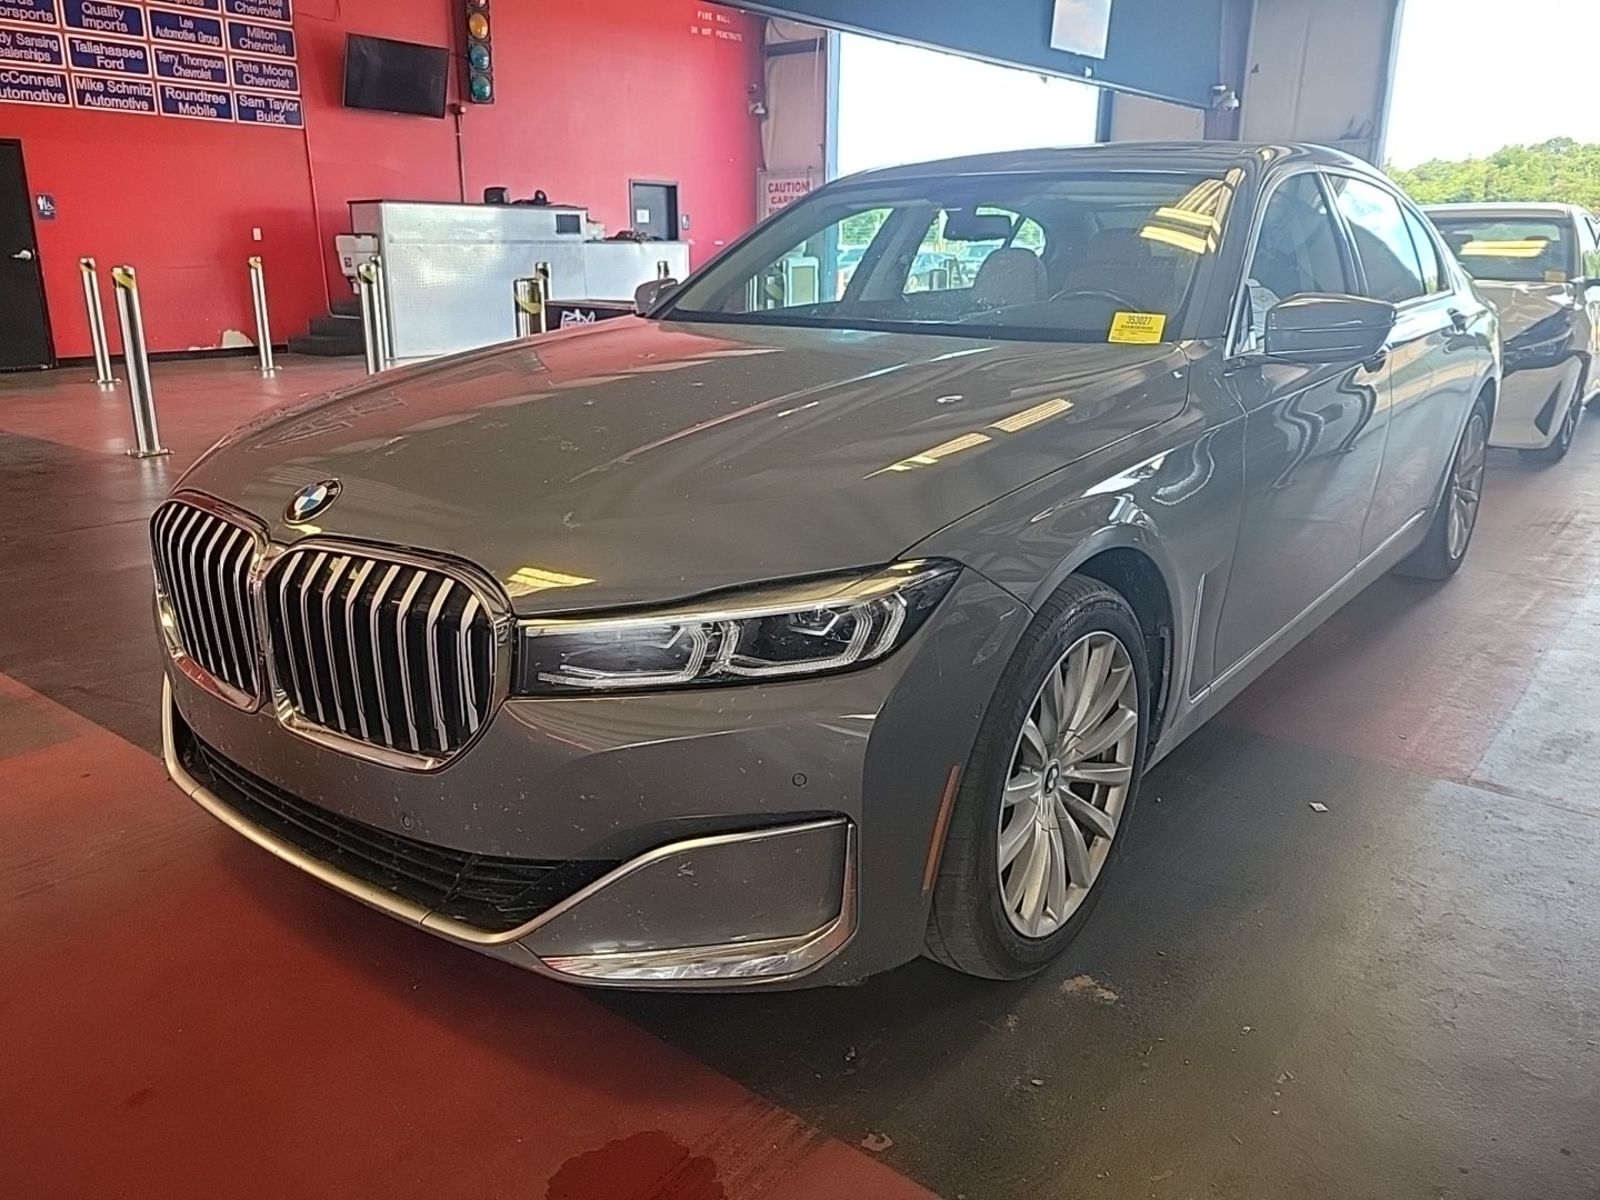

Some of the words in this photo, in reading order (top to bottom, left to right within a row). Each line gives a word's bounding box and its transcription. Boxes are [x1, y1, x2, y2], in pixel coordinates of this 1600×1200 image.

[81, 1, 125, 21] Quality
[234, 1, 282, 18] Chevrolet
[81, 13, 129, 32] Imports
[178, 15, 194, 29] Lee
[15, 32, 59, 52] Sansing
[155, 25, 197, 42] Automotive
[197, 31, 220, 46] Group
[246, 26, 278, 42] Milton
[72, 39, 144, 59] Tallahassee
[239, 37, 287, 54] Chevrolet
[96, 55, 125, 70] Ford
[156, 50, 179, 65] Terry
[180, 53, 224, 69] Thompson
[172, 65, 212, 80] Chevrolet
[235, 60, 259, 74] Pete
[262, 63, 294, 78] Moore
[75, 77, 105, 91] Mike
[107, 80, 153, 97] Schmitz
[242, 73, 290, 89] Chevrolet
[84, 92, 149, 110] Automotive
[165, 86, 226, 105] Roundtree
[239, 95, 265, 109] Sam
[266, 97, 299, 112] Taylor
[178, 101, 217, 117] Mobile
[256, 109, 286, 124] Buick
